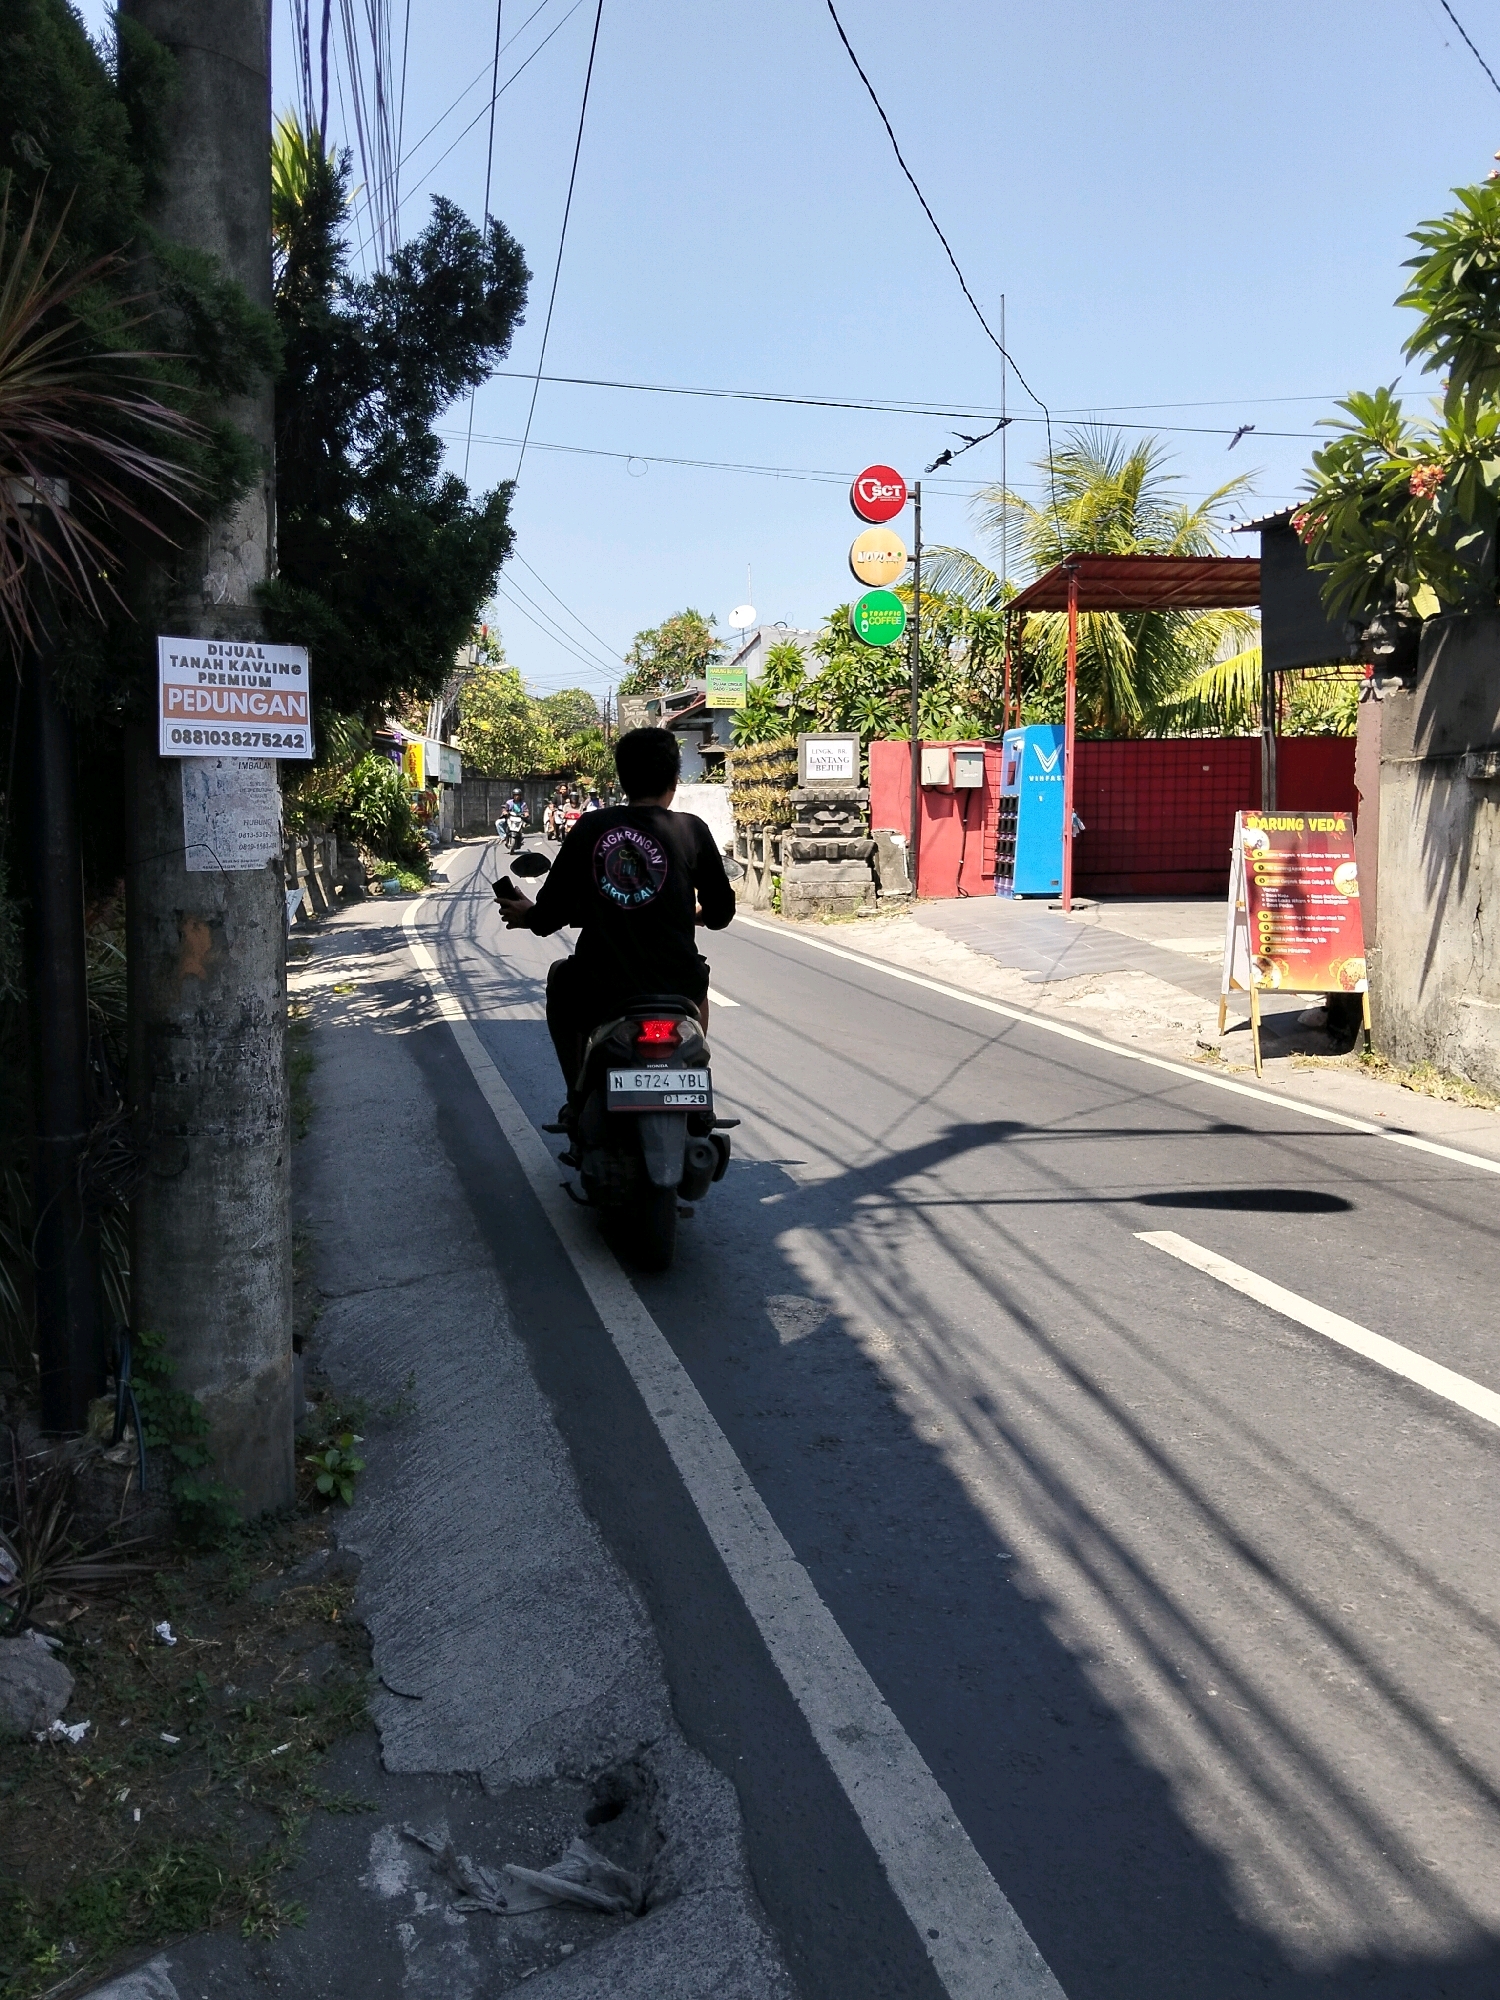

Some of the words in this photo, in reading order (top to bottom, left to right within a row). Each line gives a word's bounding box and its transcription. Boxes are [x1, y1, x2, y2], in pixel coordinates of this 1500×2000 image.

[871, 484, 903, 497] SCT
[868, 616, 902, 625] COFFEE
[207, 643, 265, 659] DIJUAL
[169, 654, 224, 670] TANAH
[228, 660, 302, 675] KAVLING
[198, 671, 272, 687] PREMIUM
[168, 687, 306, 717] PEDUNGAN
[171, 728, 305, 749] 0881038275242
[809, 756, 850, 764] LANTANG
[815, 764, 843, 772] BEJUH
[1247, 817, 1305, 831] WARUNG
[1308, 818, 1346, 832] VEDA
[601, 876, 630, 904] PARTY
[615, 1076, 623, 1089] N
[635, 1074, 670, 1088] 6724
[679, 1074, 705, 1088] YBL
